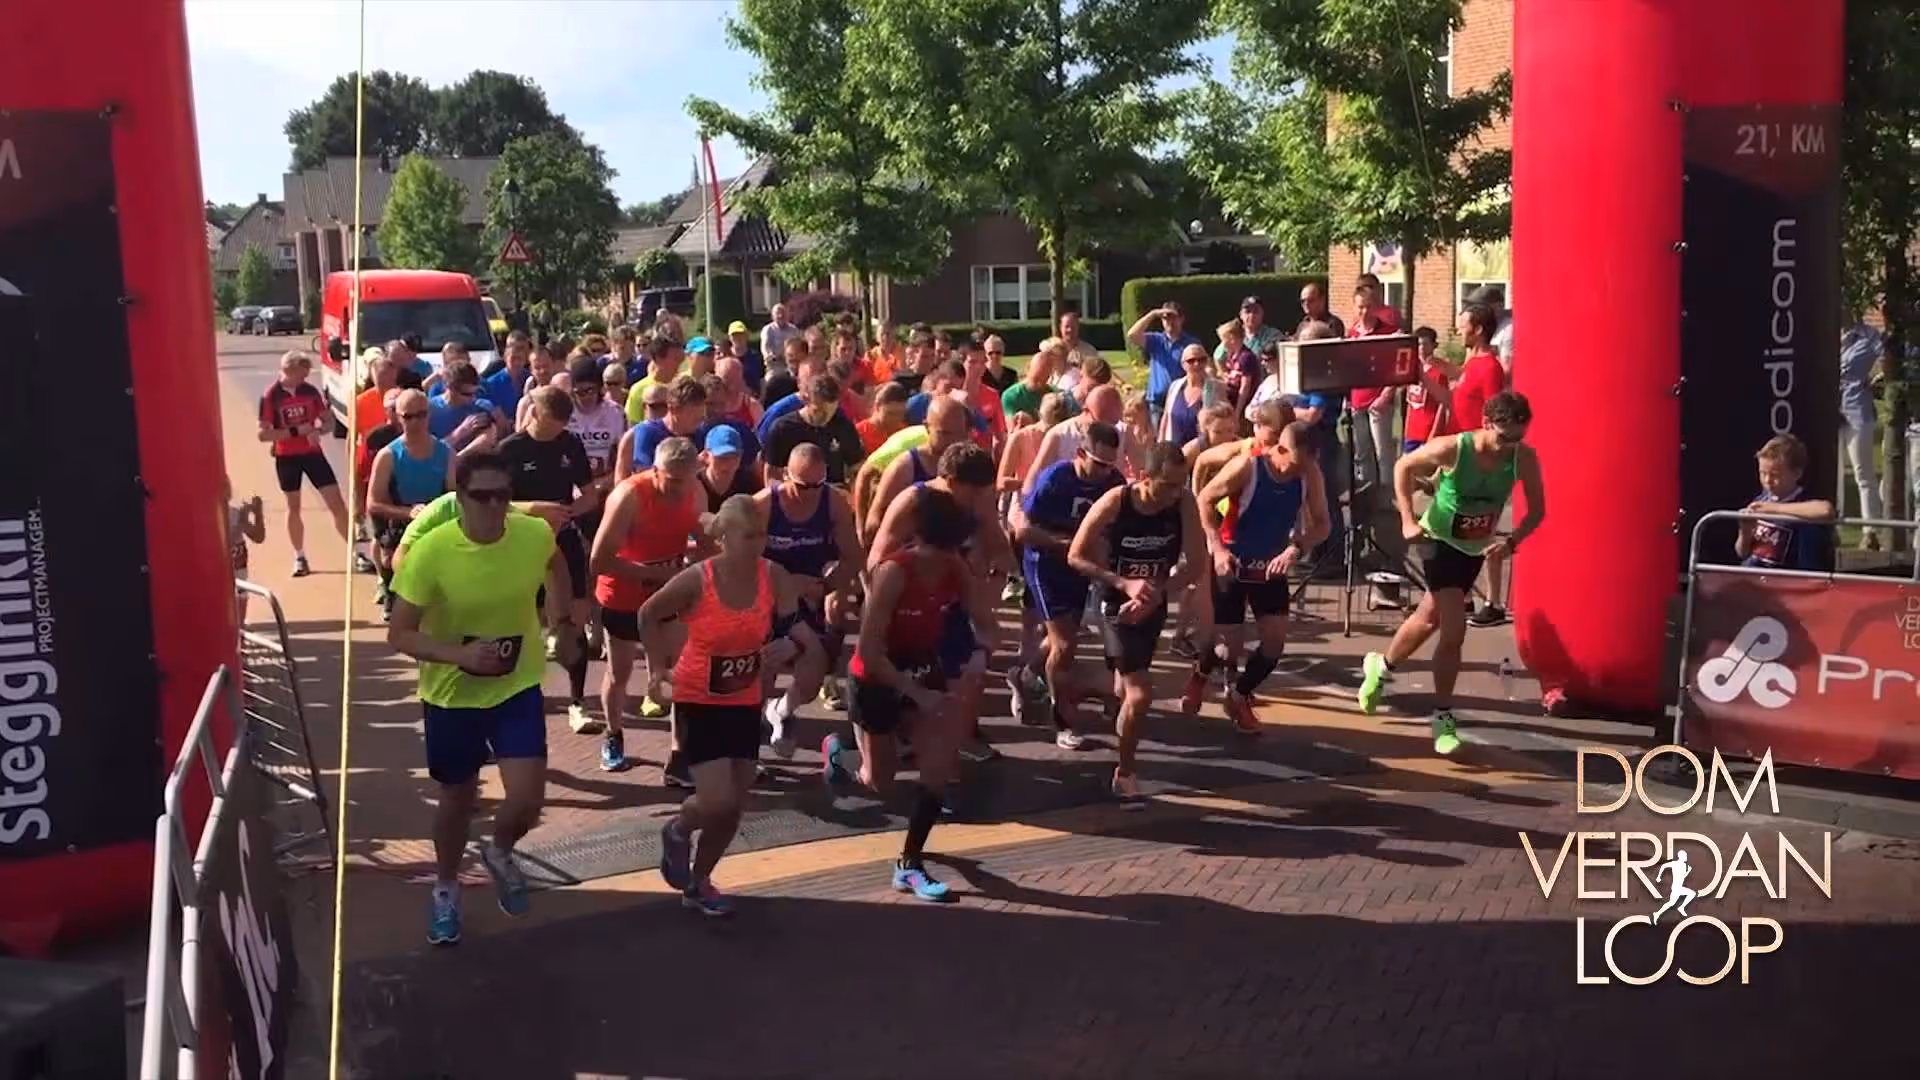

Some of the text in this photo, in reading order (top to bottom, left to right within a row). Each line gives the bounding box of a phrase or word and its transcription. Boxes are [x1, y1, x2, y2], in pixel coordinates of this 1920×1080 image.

[1791, 123, 1825, 154] KM
[28, 496, 55, 654] PROJECTMANAGEM
[1818, 653, 1920, 701] Pr
